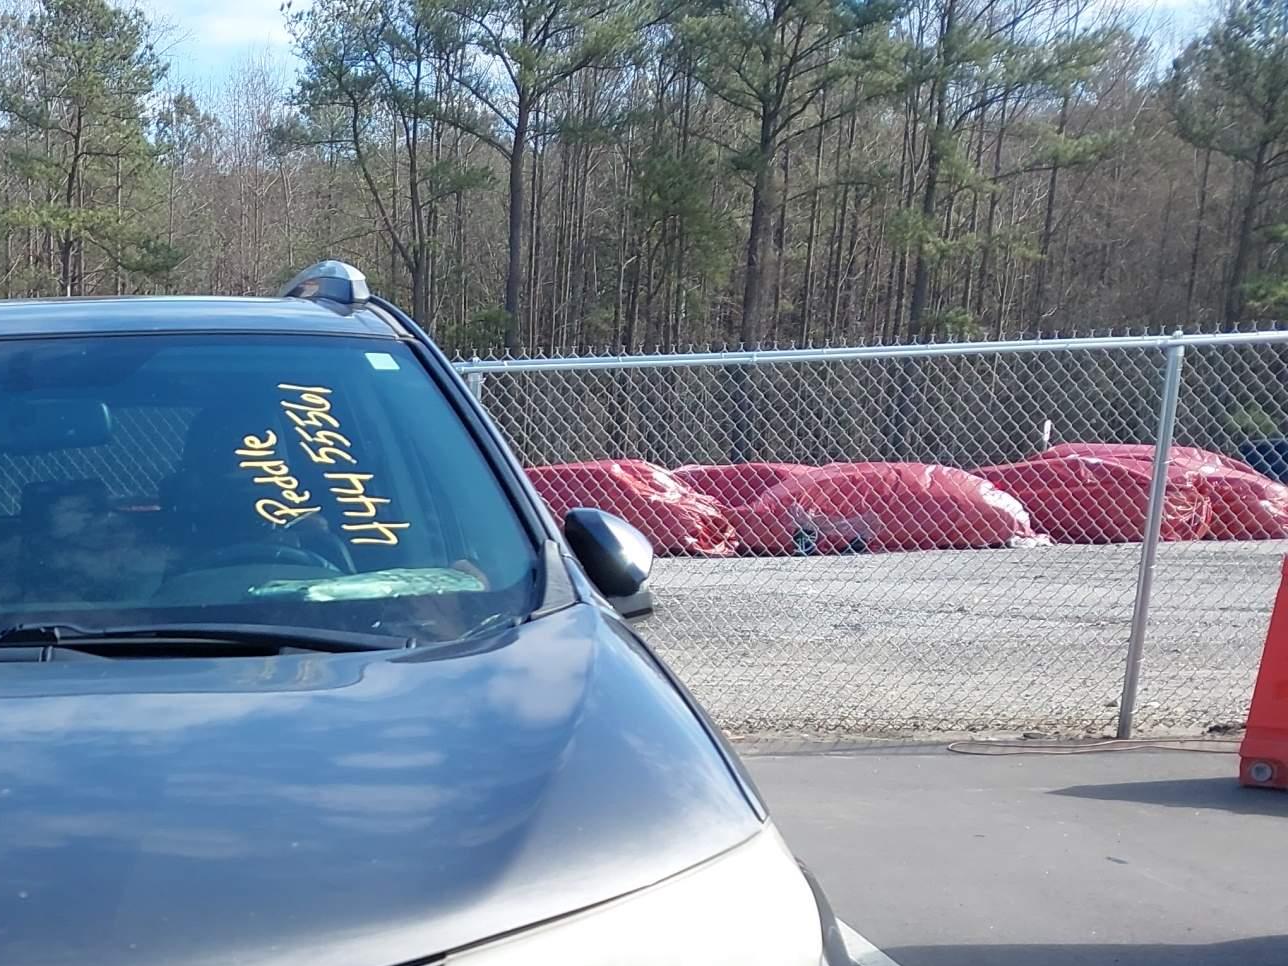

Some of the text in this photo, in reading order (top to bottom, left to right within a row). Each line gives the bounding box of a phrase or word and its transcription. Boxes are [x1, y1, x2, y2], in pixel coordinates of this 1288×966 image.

[234, 430, 321, 526] Peddle
[277, 383, 410, 545] 444 55561
